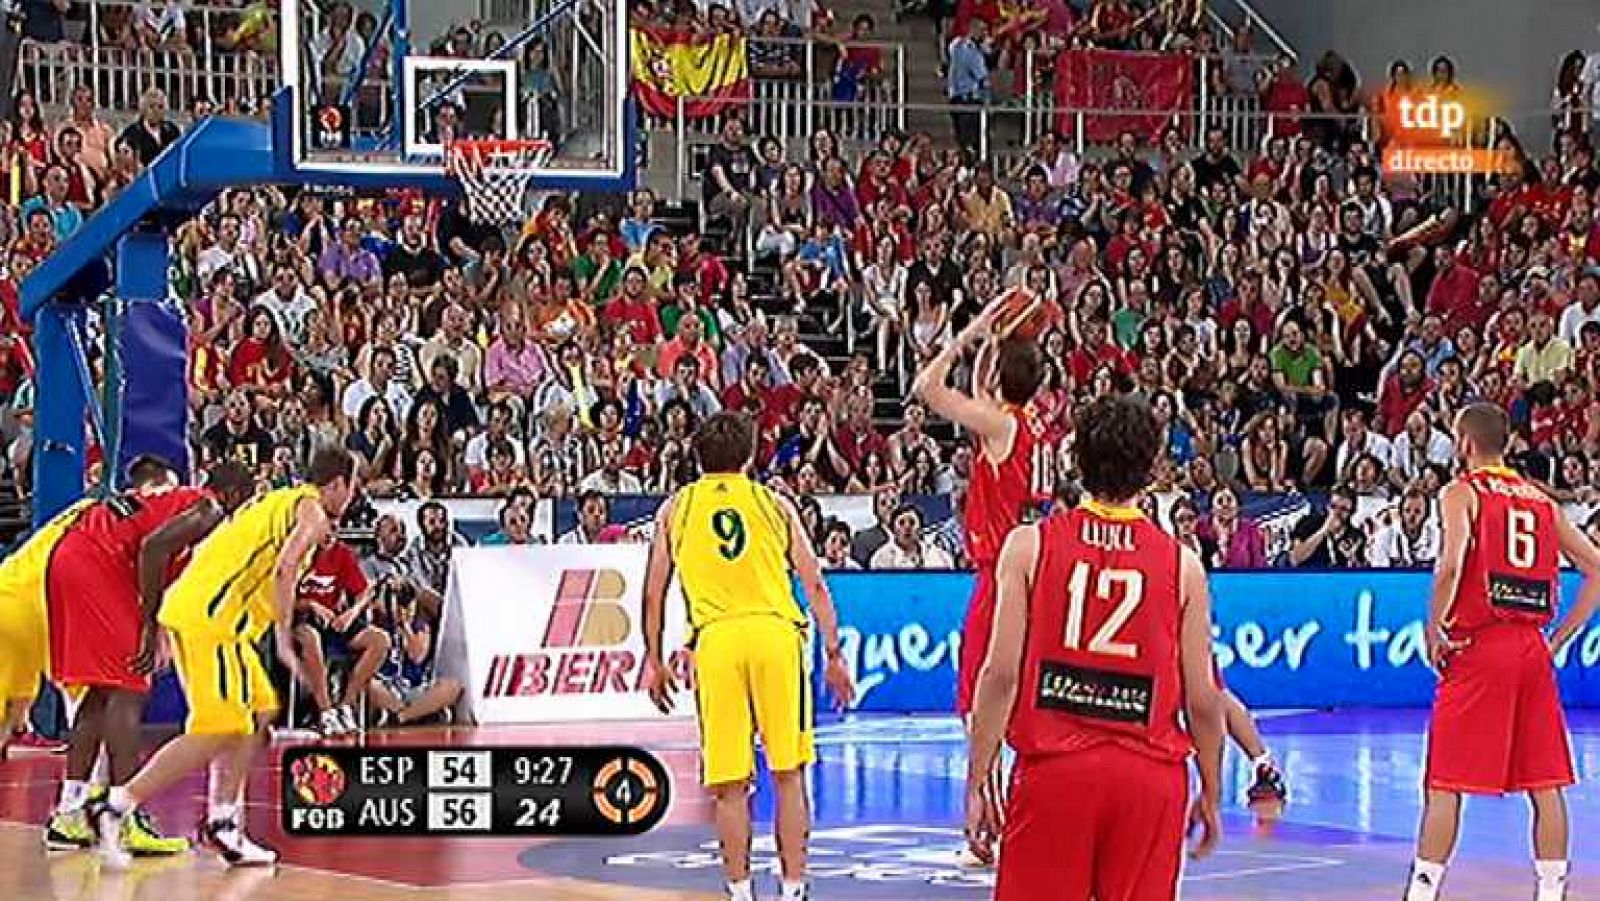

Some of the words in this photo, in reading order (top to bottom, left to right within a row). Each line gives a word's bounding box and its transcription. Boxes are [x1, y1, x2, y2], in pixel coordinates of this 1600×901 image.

[712, 508, 746, 561] 9
[1507, 507, 1535, 568] 6
[1064, 560, 1143, 658] 12
